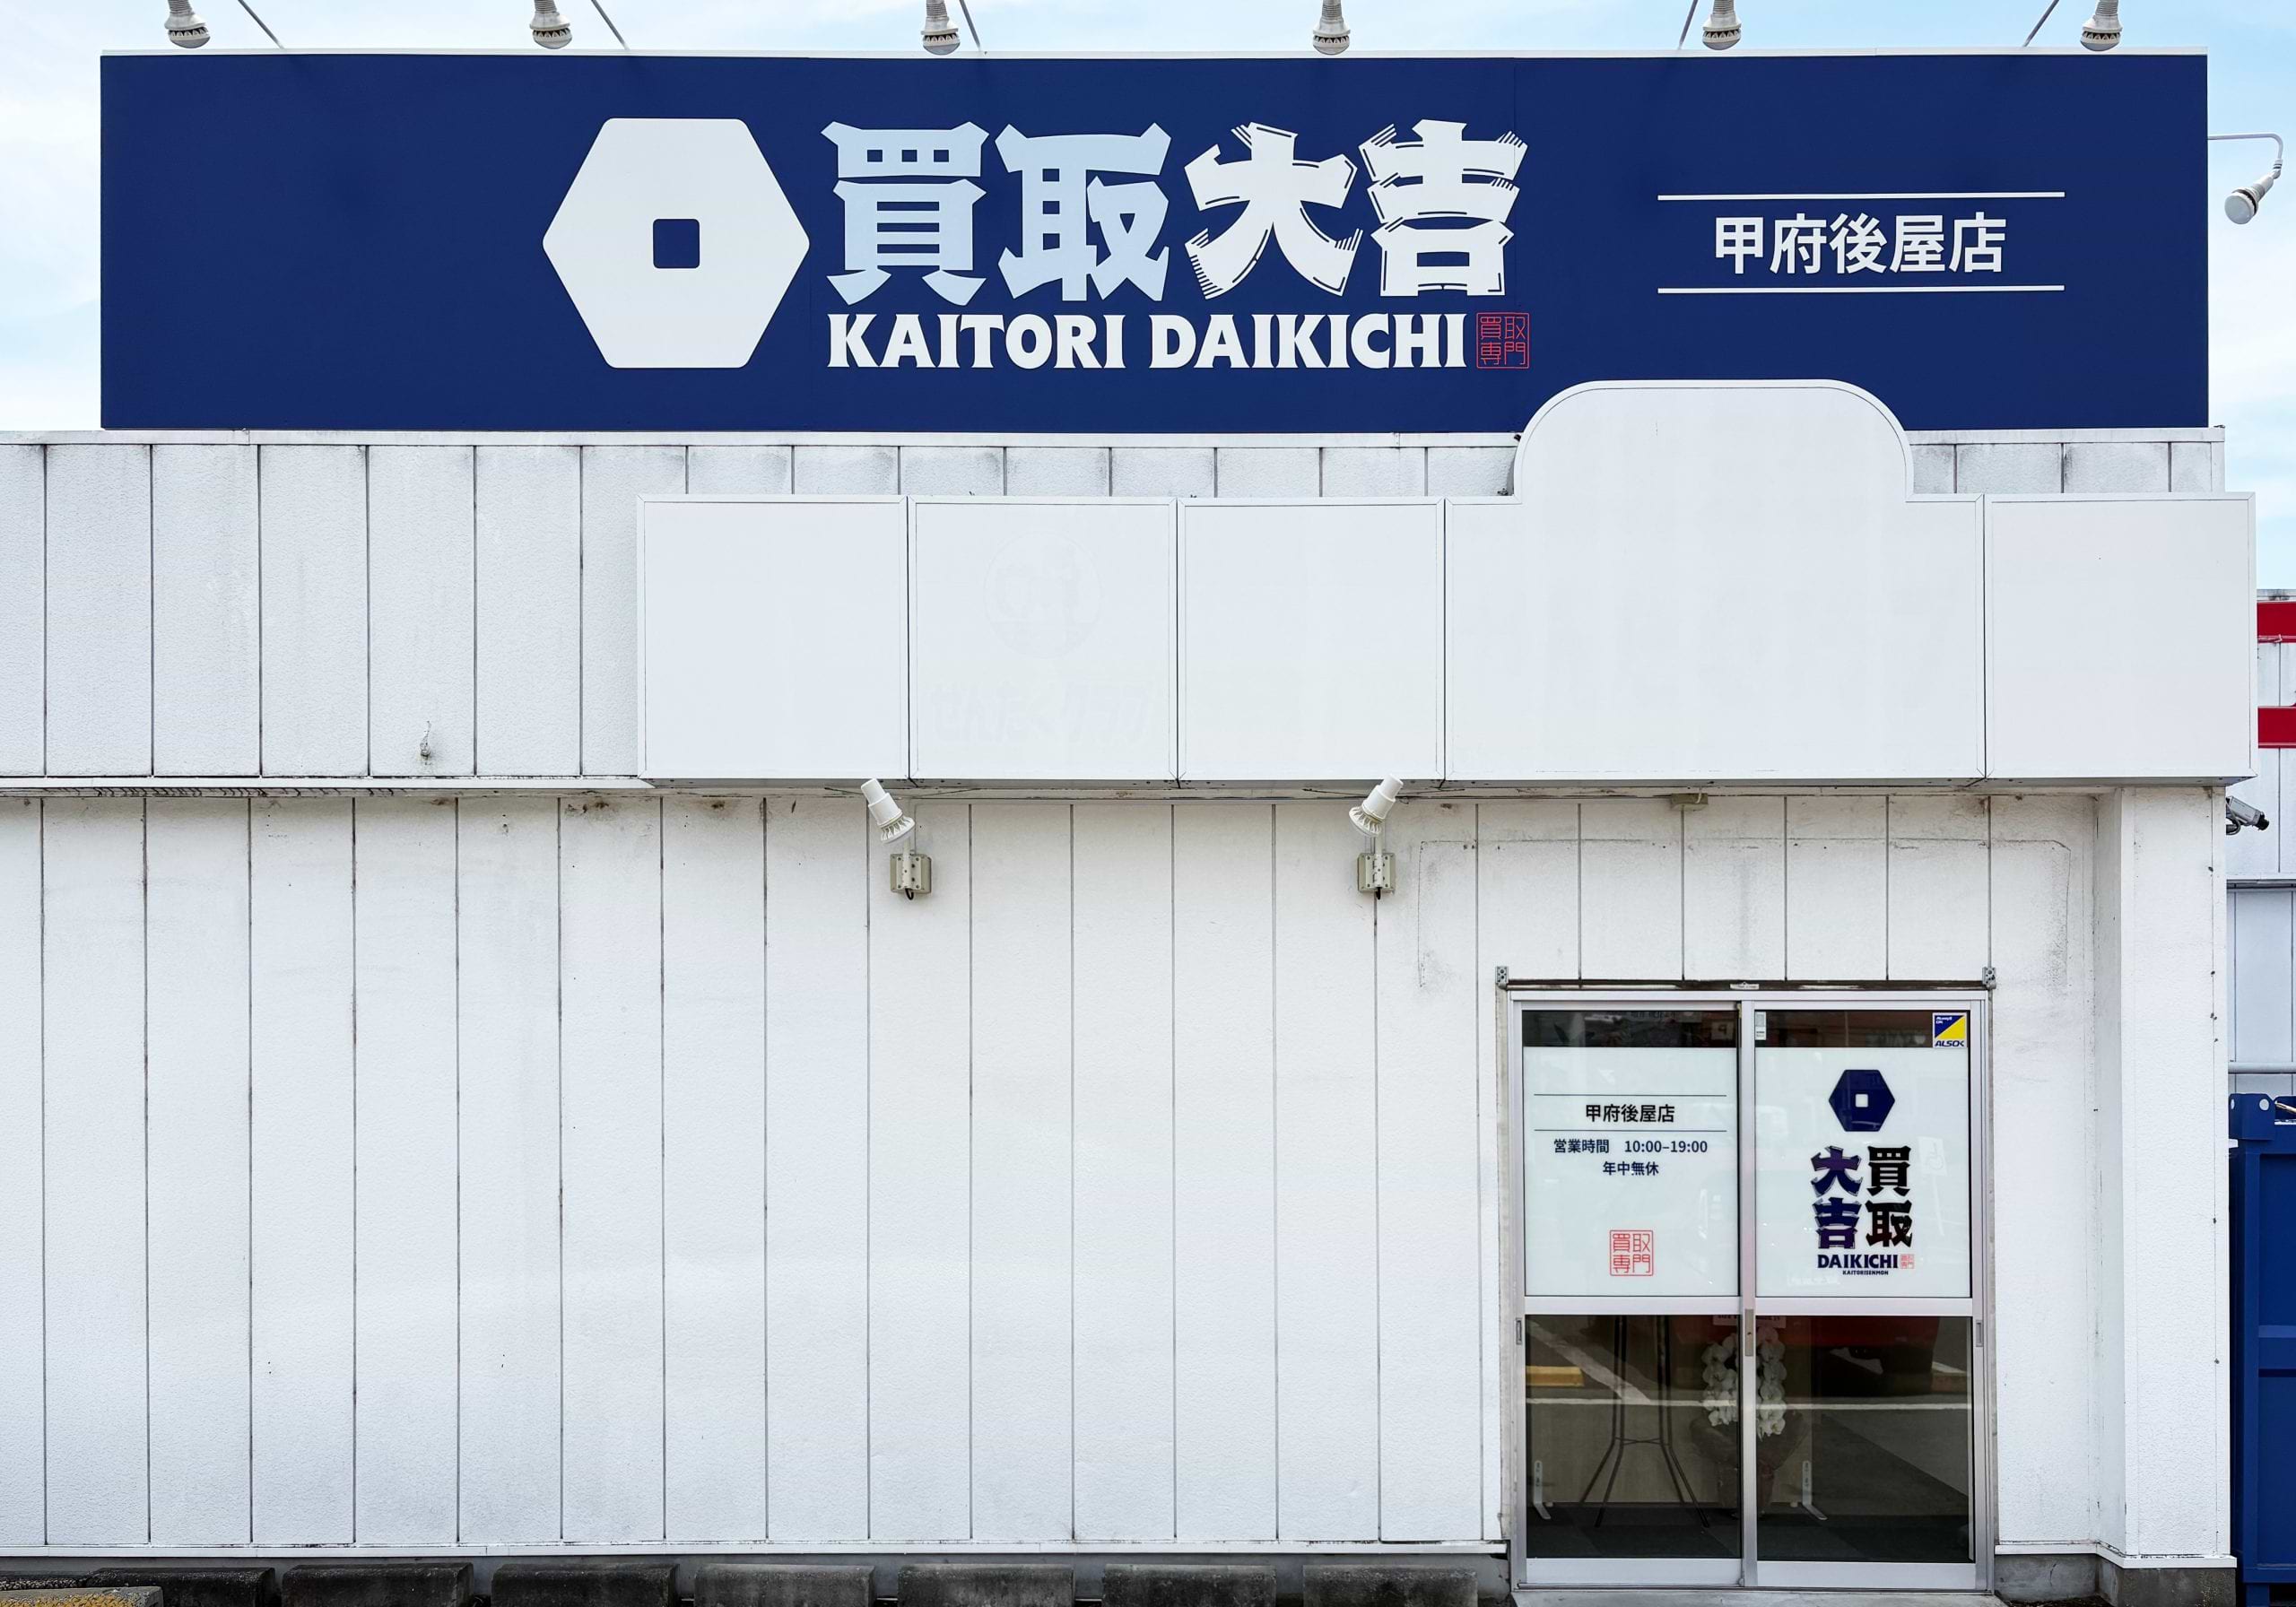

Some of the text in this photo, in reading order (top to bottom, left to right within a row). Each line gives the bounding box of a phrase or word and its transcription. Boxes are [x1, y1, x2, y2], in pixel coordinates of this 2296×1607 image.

[821, 118, 1528, 306] 買取大吉
[1715, 211, 2006, 274] 甲府後屋店
[827, 313, 1467, 369] KAITORI DAIKICHI
[1585, 1103, 1675, 1124] 甲府後屋店
[1553, 1138, 1610, 1154] 営業時間
[1602, 1160, 1659, 1177] 年中無休
[1817, 1254, 1899, 1269] DAIKICHI
